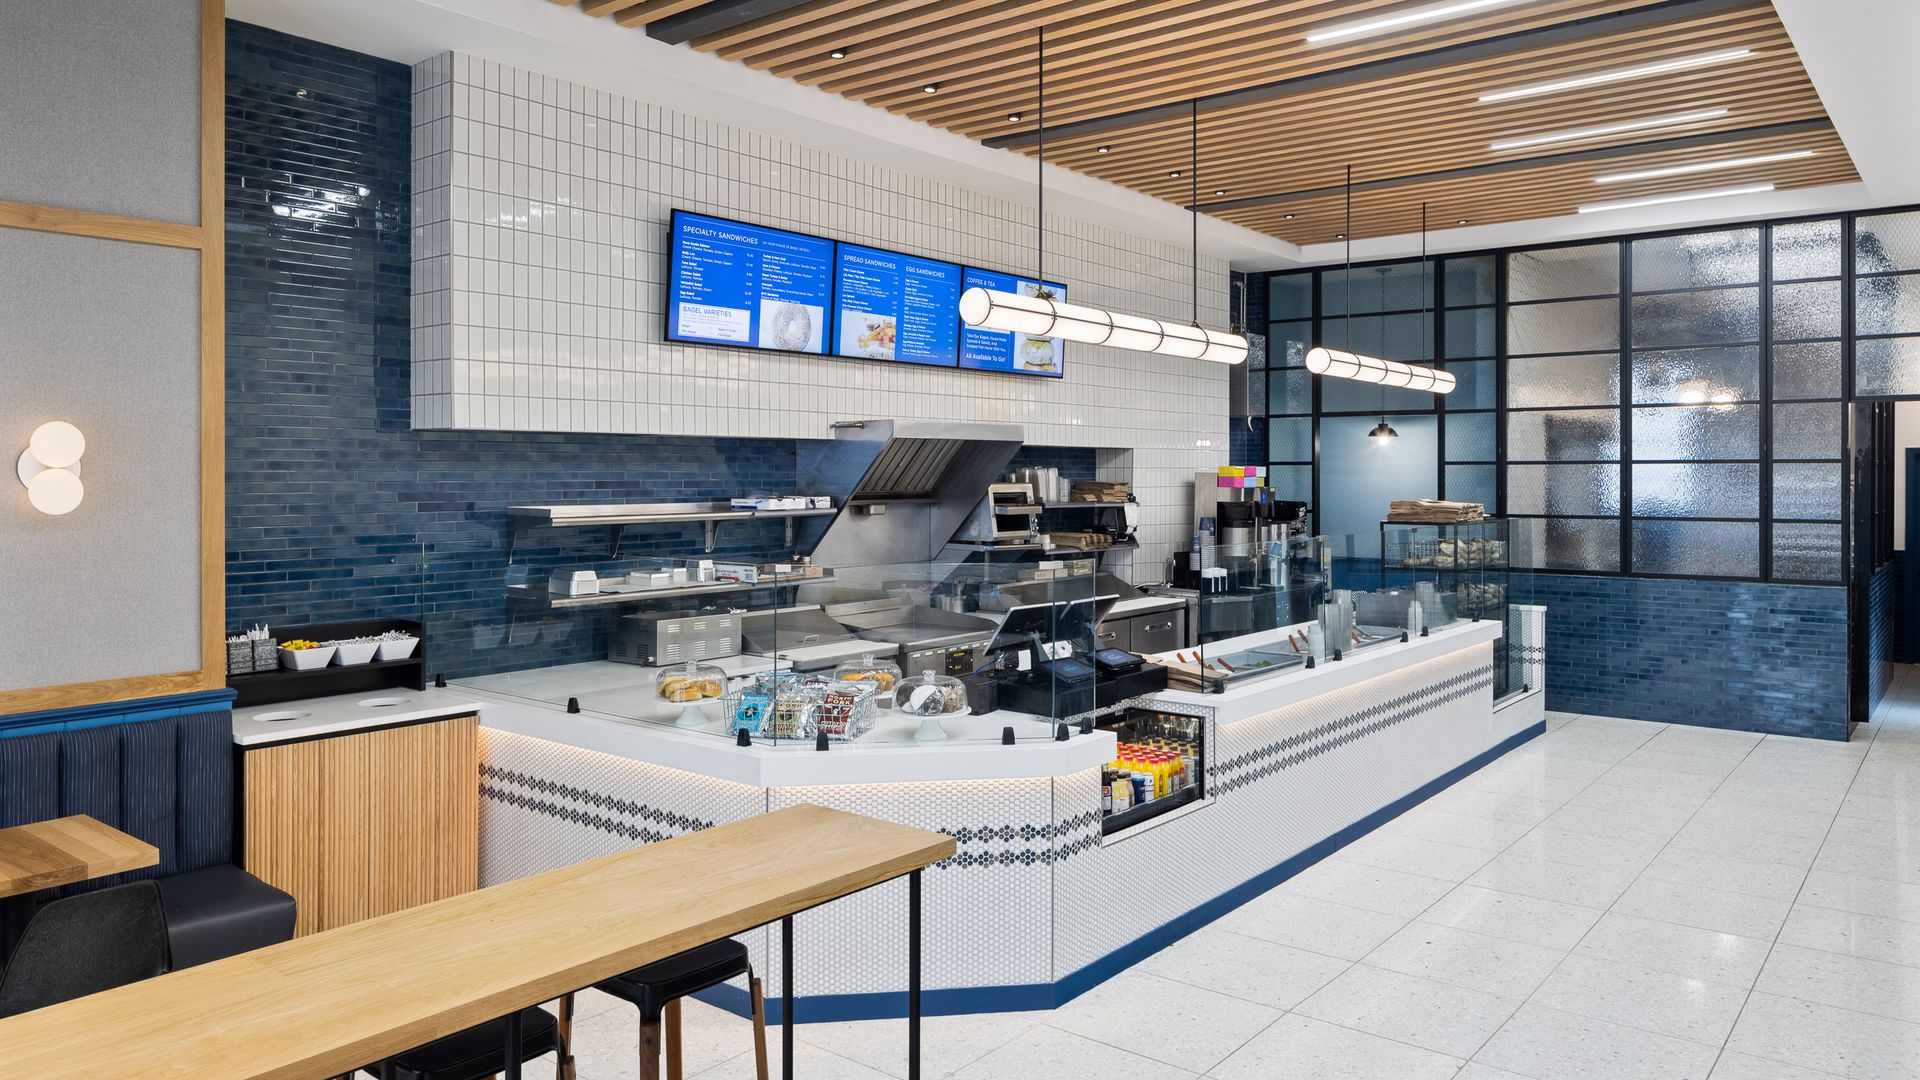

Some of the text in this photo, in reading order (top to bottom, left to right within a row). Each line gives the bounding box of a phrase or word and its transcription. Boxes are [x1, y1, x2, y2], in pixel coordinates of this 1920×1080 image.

[683, 225, 758, 244] SPECIALTY SANDWICHES
[844, 254, 896, 270] SPREAD SANDWICHES
[916, 268, 945, 278] SANDWICHES
[966, 277, 983, 286] COFFEE
[682, 306, 732, 318] BAGEL VARIETIES
[973, 353, 992, 361] Available
